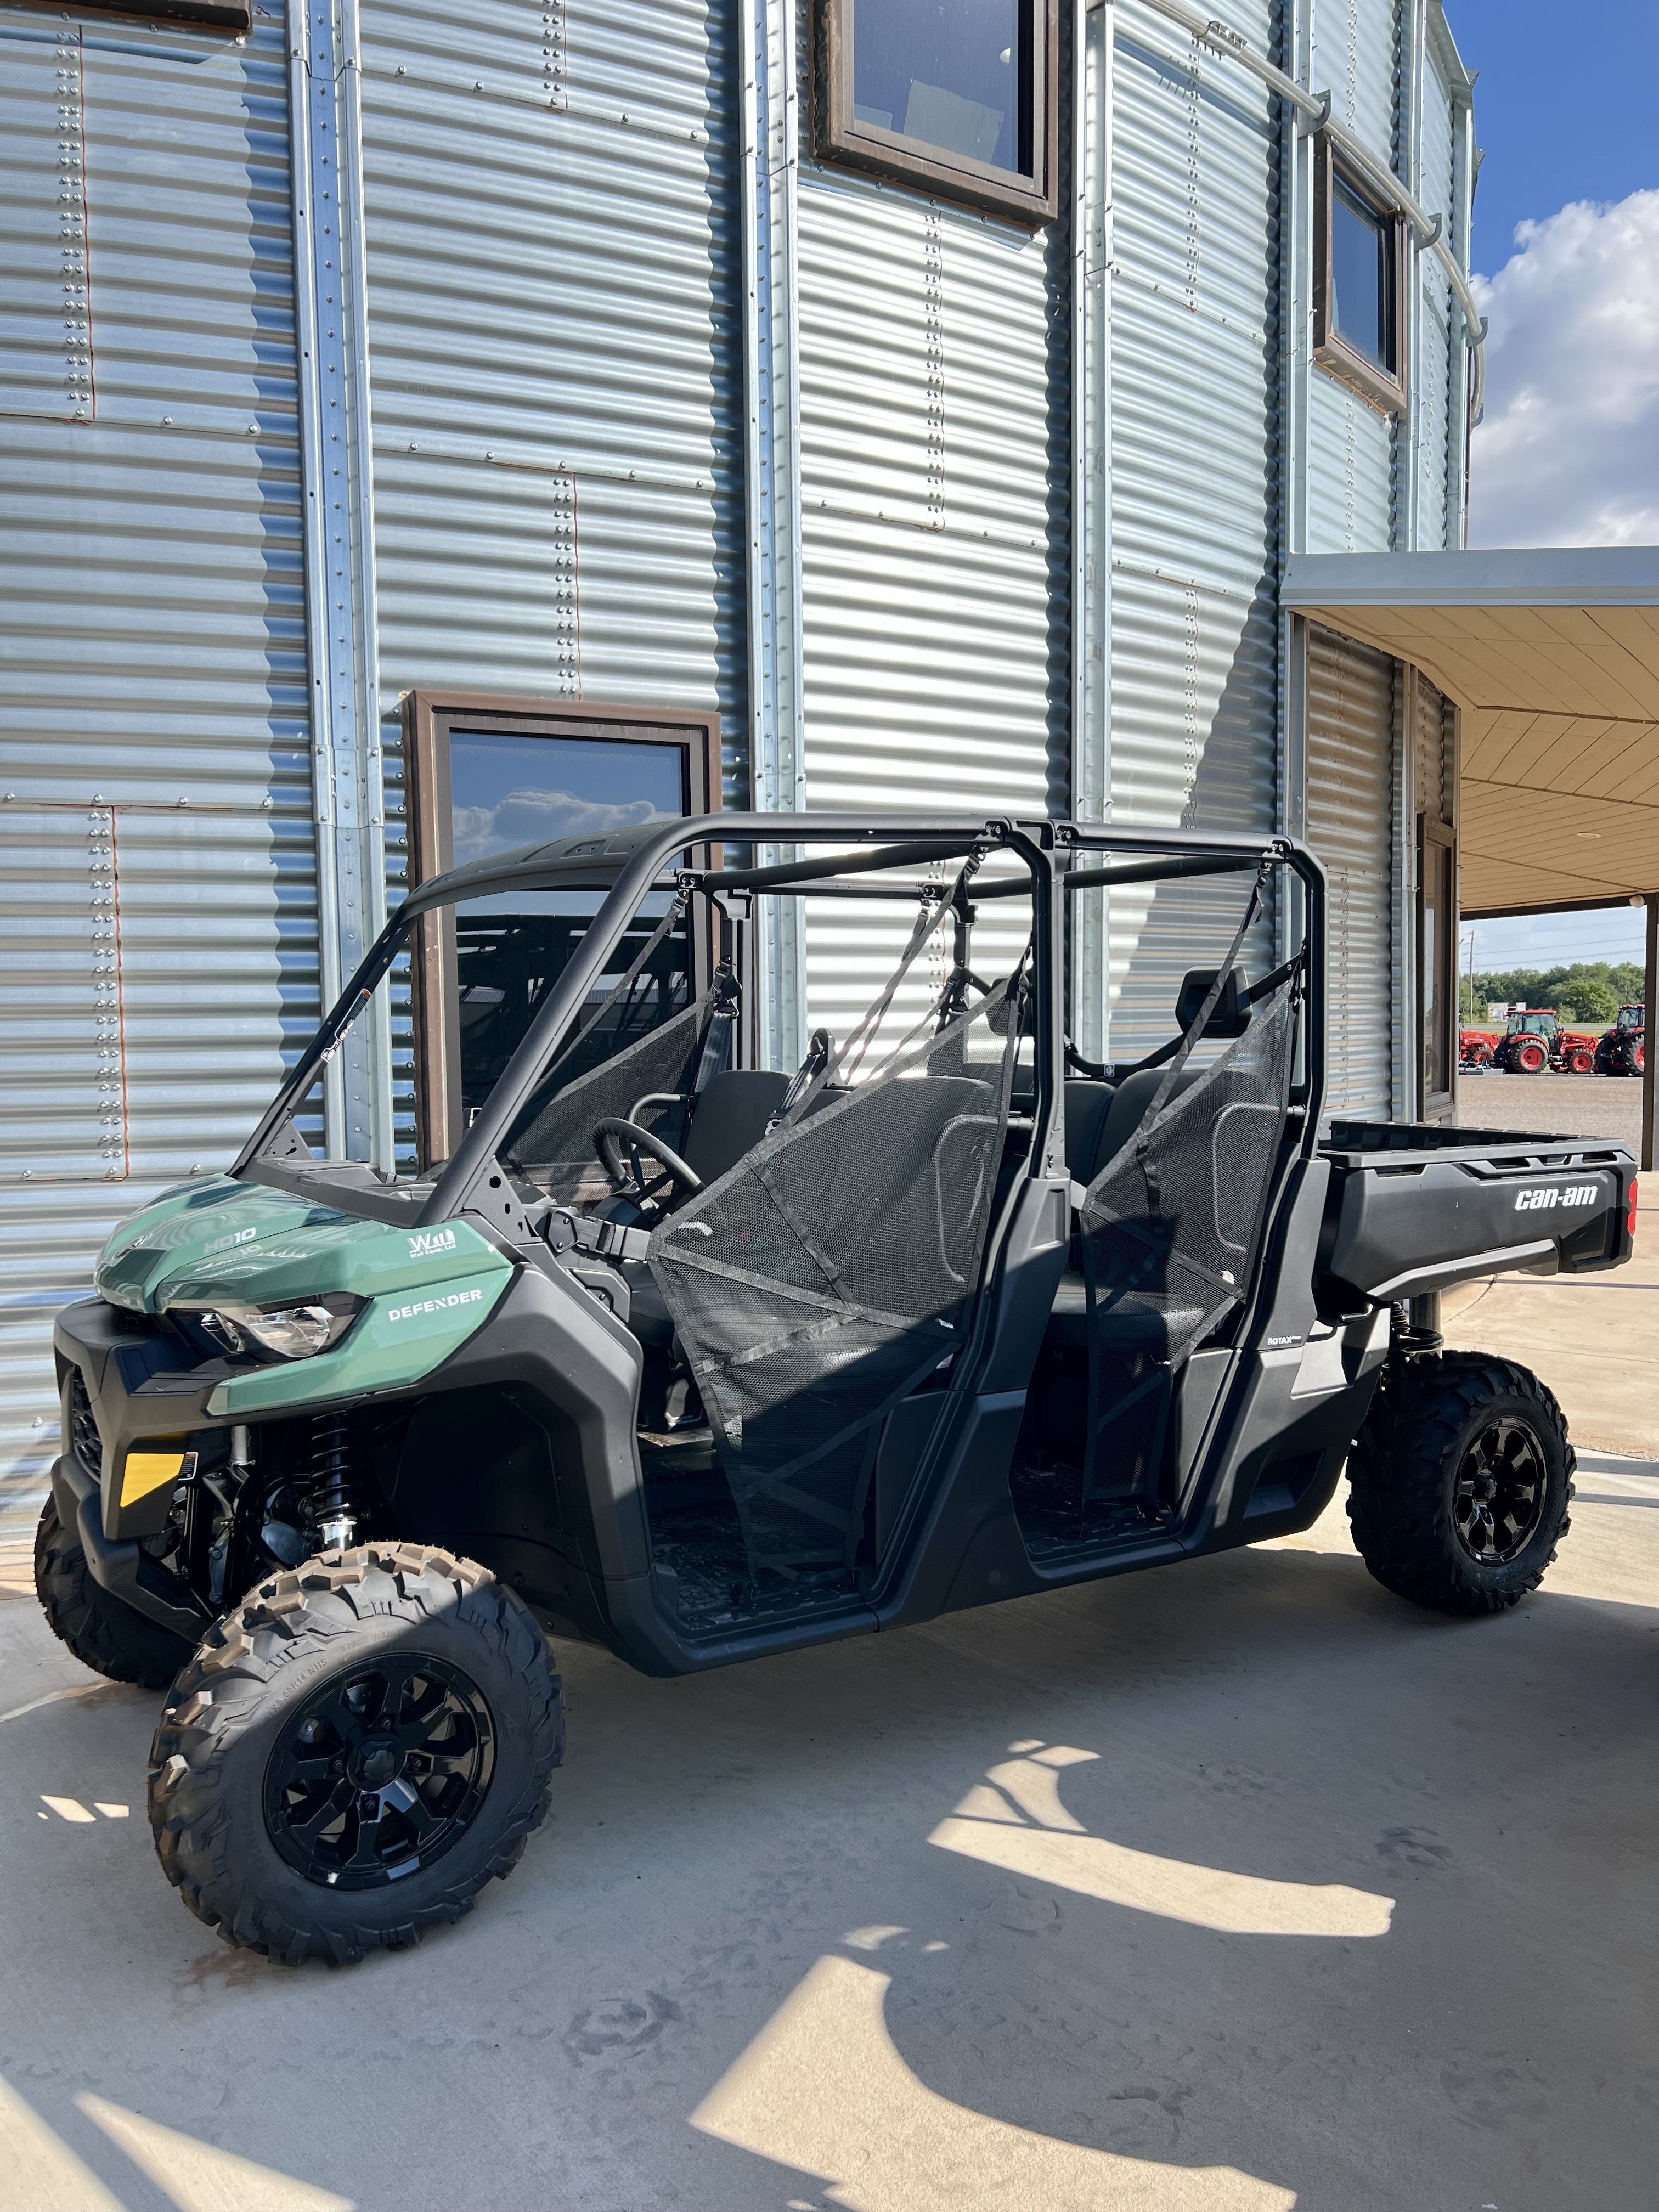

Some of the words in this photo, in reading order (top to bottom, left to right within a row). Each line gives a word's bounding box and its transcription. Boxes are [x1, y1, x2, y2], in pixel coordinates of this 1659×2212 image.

[1515, 1186, 1598, 1210] can-am
[204, 1227, 256, 1254] HD10
[388, 1289, 483, 1321] DEFENDER
[1267, 1336, 1293, 1346] ROTAX
